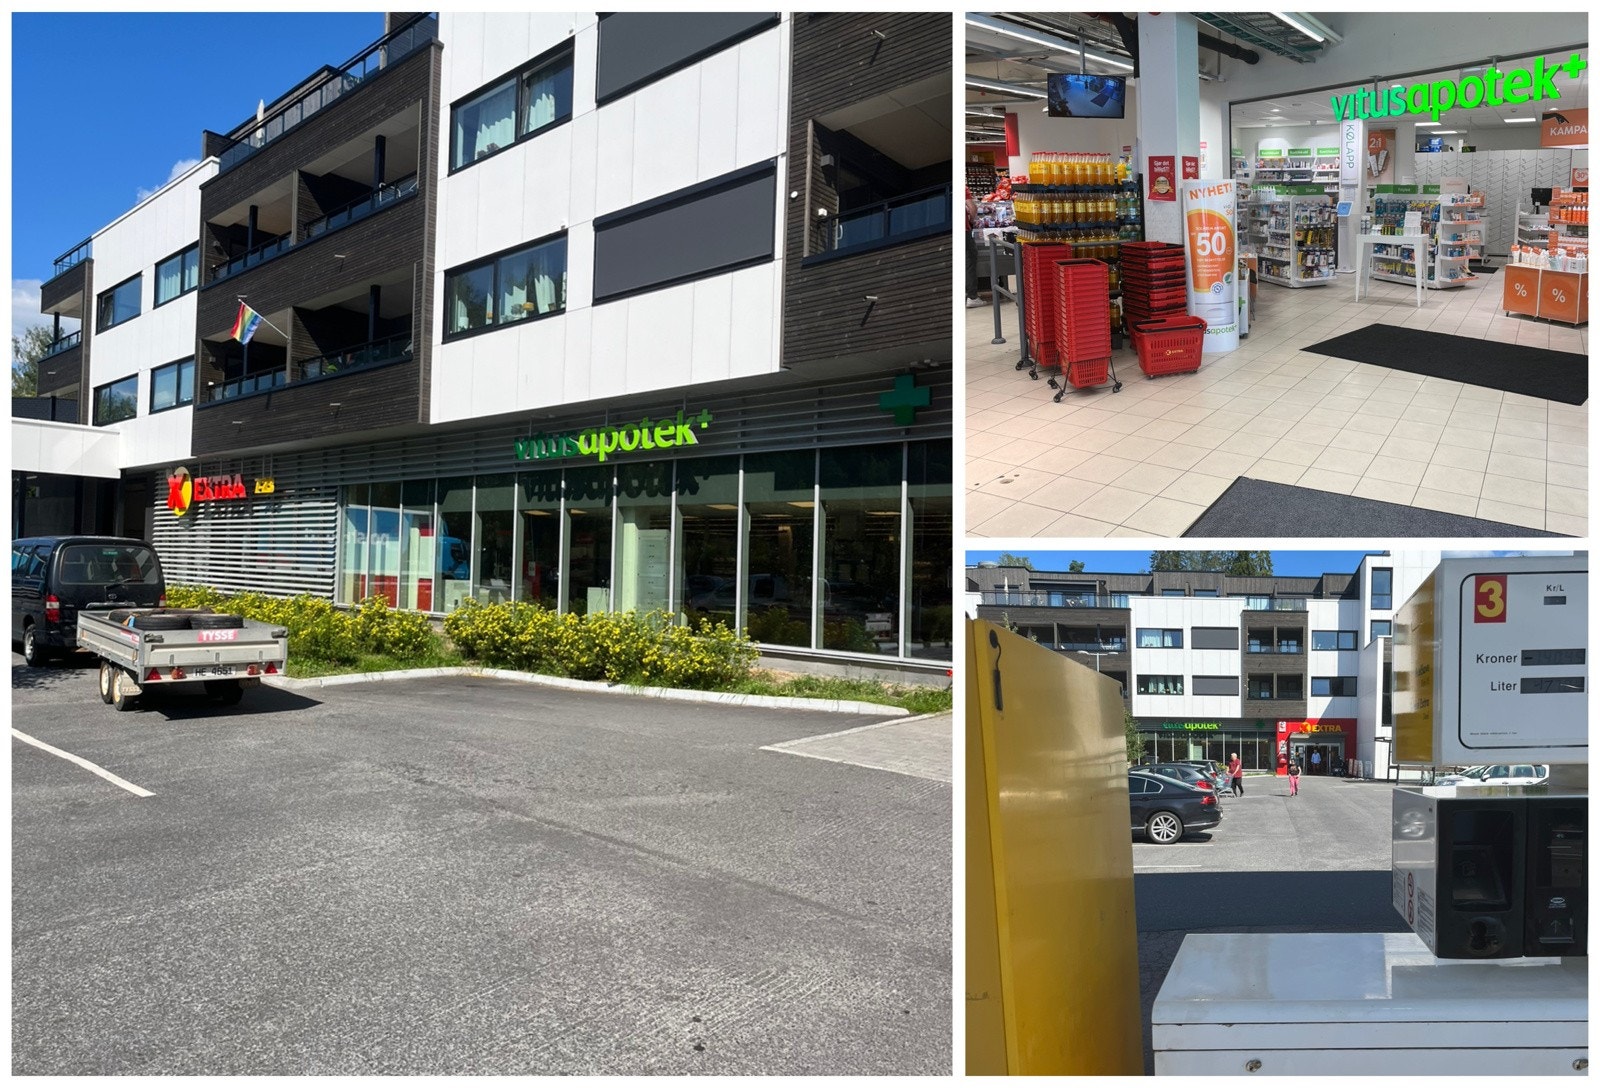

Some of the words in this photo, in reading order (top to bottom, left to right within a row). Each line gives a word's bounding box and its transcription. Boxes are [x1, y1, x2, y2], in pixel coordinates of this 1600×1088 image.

[1345, 124, 1355, 169] KØLAPP
[1189, 182, 1233, 200] NYHET!
[1196, 231, 1227, 256] 50
[193, 473, 247, 501] EXTRA
[1546, 584, 1565, 592] Kr/L
[1476, 580, 1505, 618] 3
[201, 629, 234, 641] TYSSE
[1476, 653, 1518, 664] Kroner
[195, 668, 206, 677] HE
[1490, 681, 1517, 691] Liter
[1312, 724, 1342, 733] EXTRA
